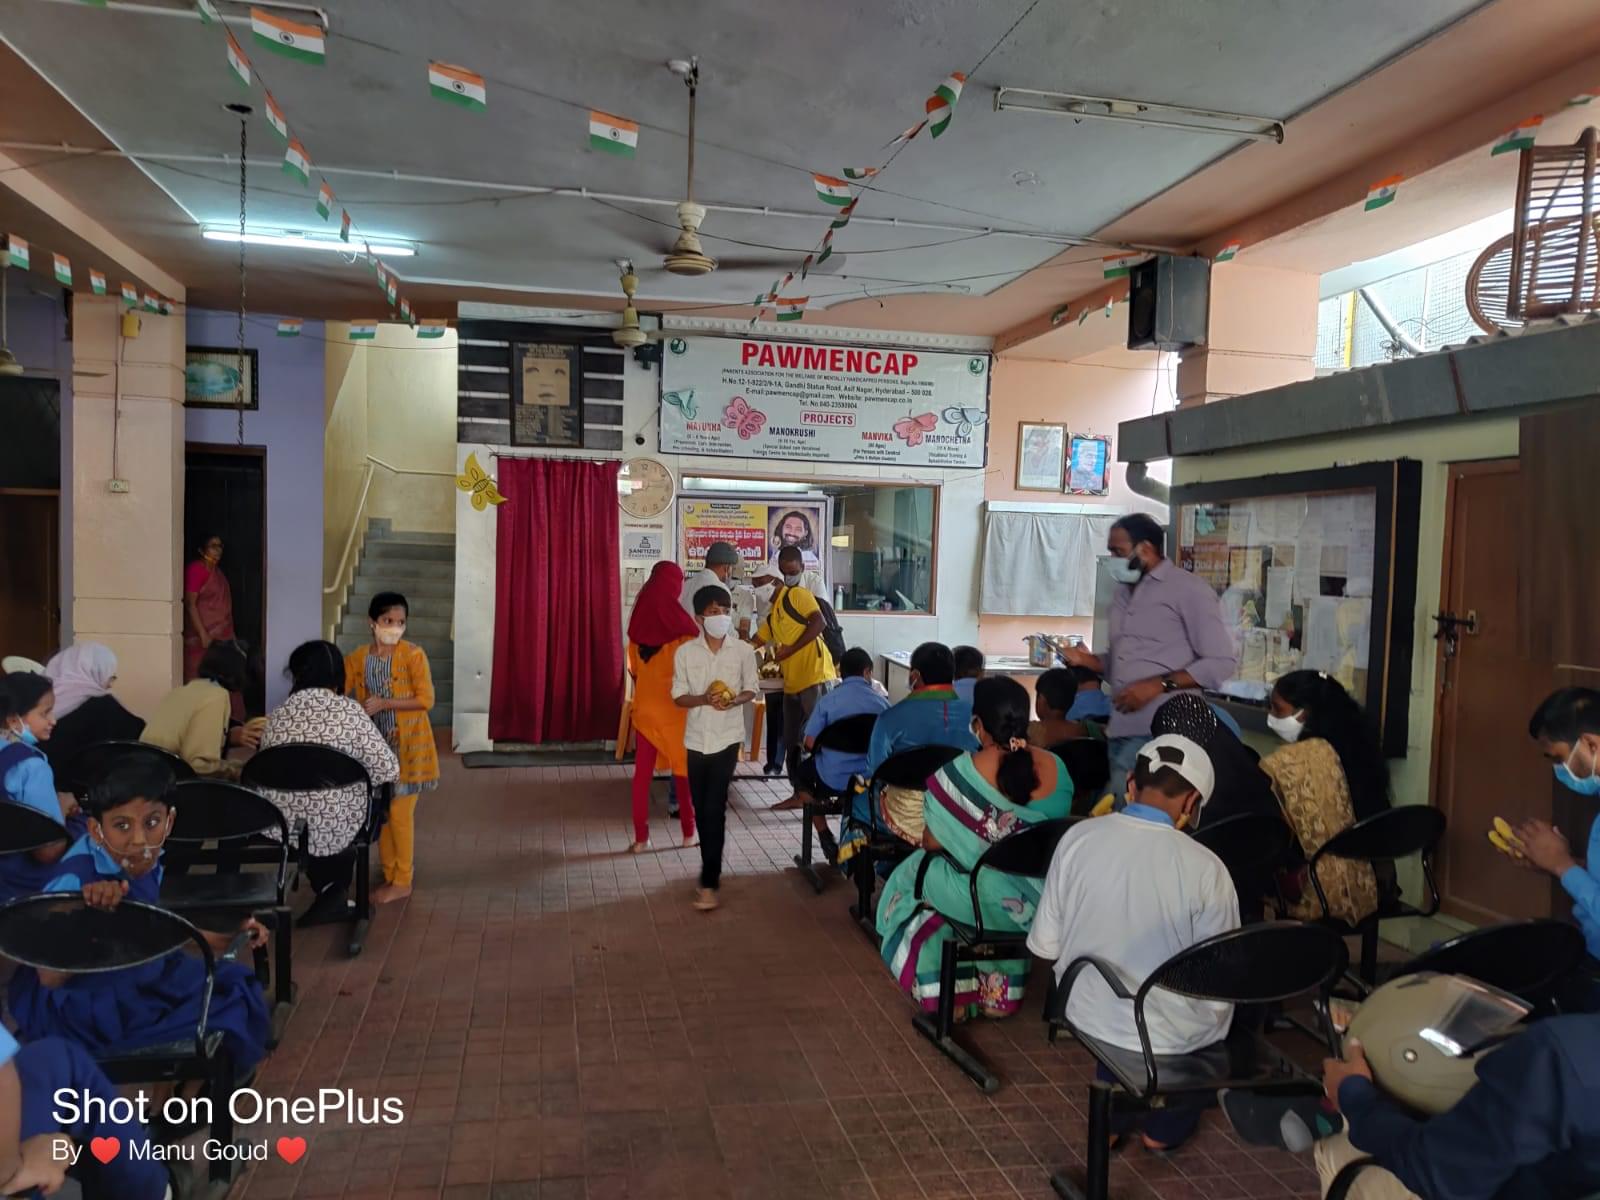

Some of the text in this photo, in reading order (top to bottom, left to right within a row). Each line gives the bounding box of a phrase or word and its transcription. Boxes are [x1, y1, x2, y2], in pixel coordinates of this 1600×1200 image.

[742, 343, 918, 376] PAWMENCAP
[784, 381, 806, 389] Gandhi
[875, 386, 905, 396] Hyderabad
[864, 394, 912, 404] pawmencap.co.in
[803, 413, 853, 425] PROJECTS
[769, 426, 816, 438] MANOKRUSHI
[861, 431, 893, 441] MANVIKA
